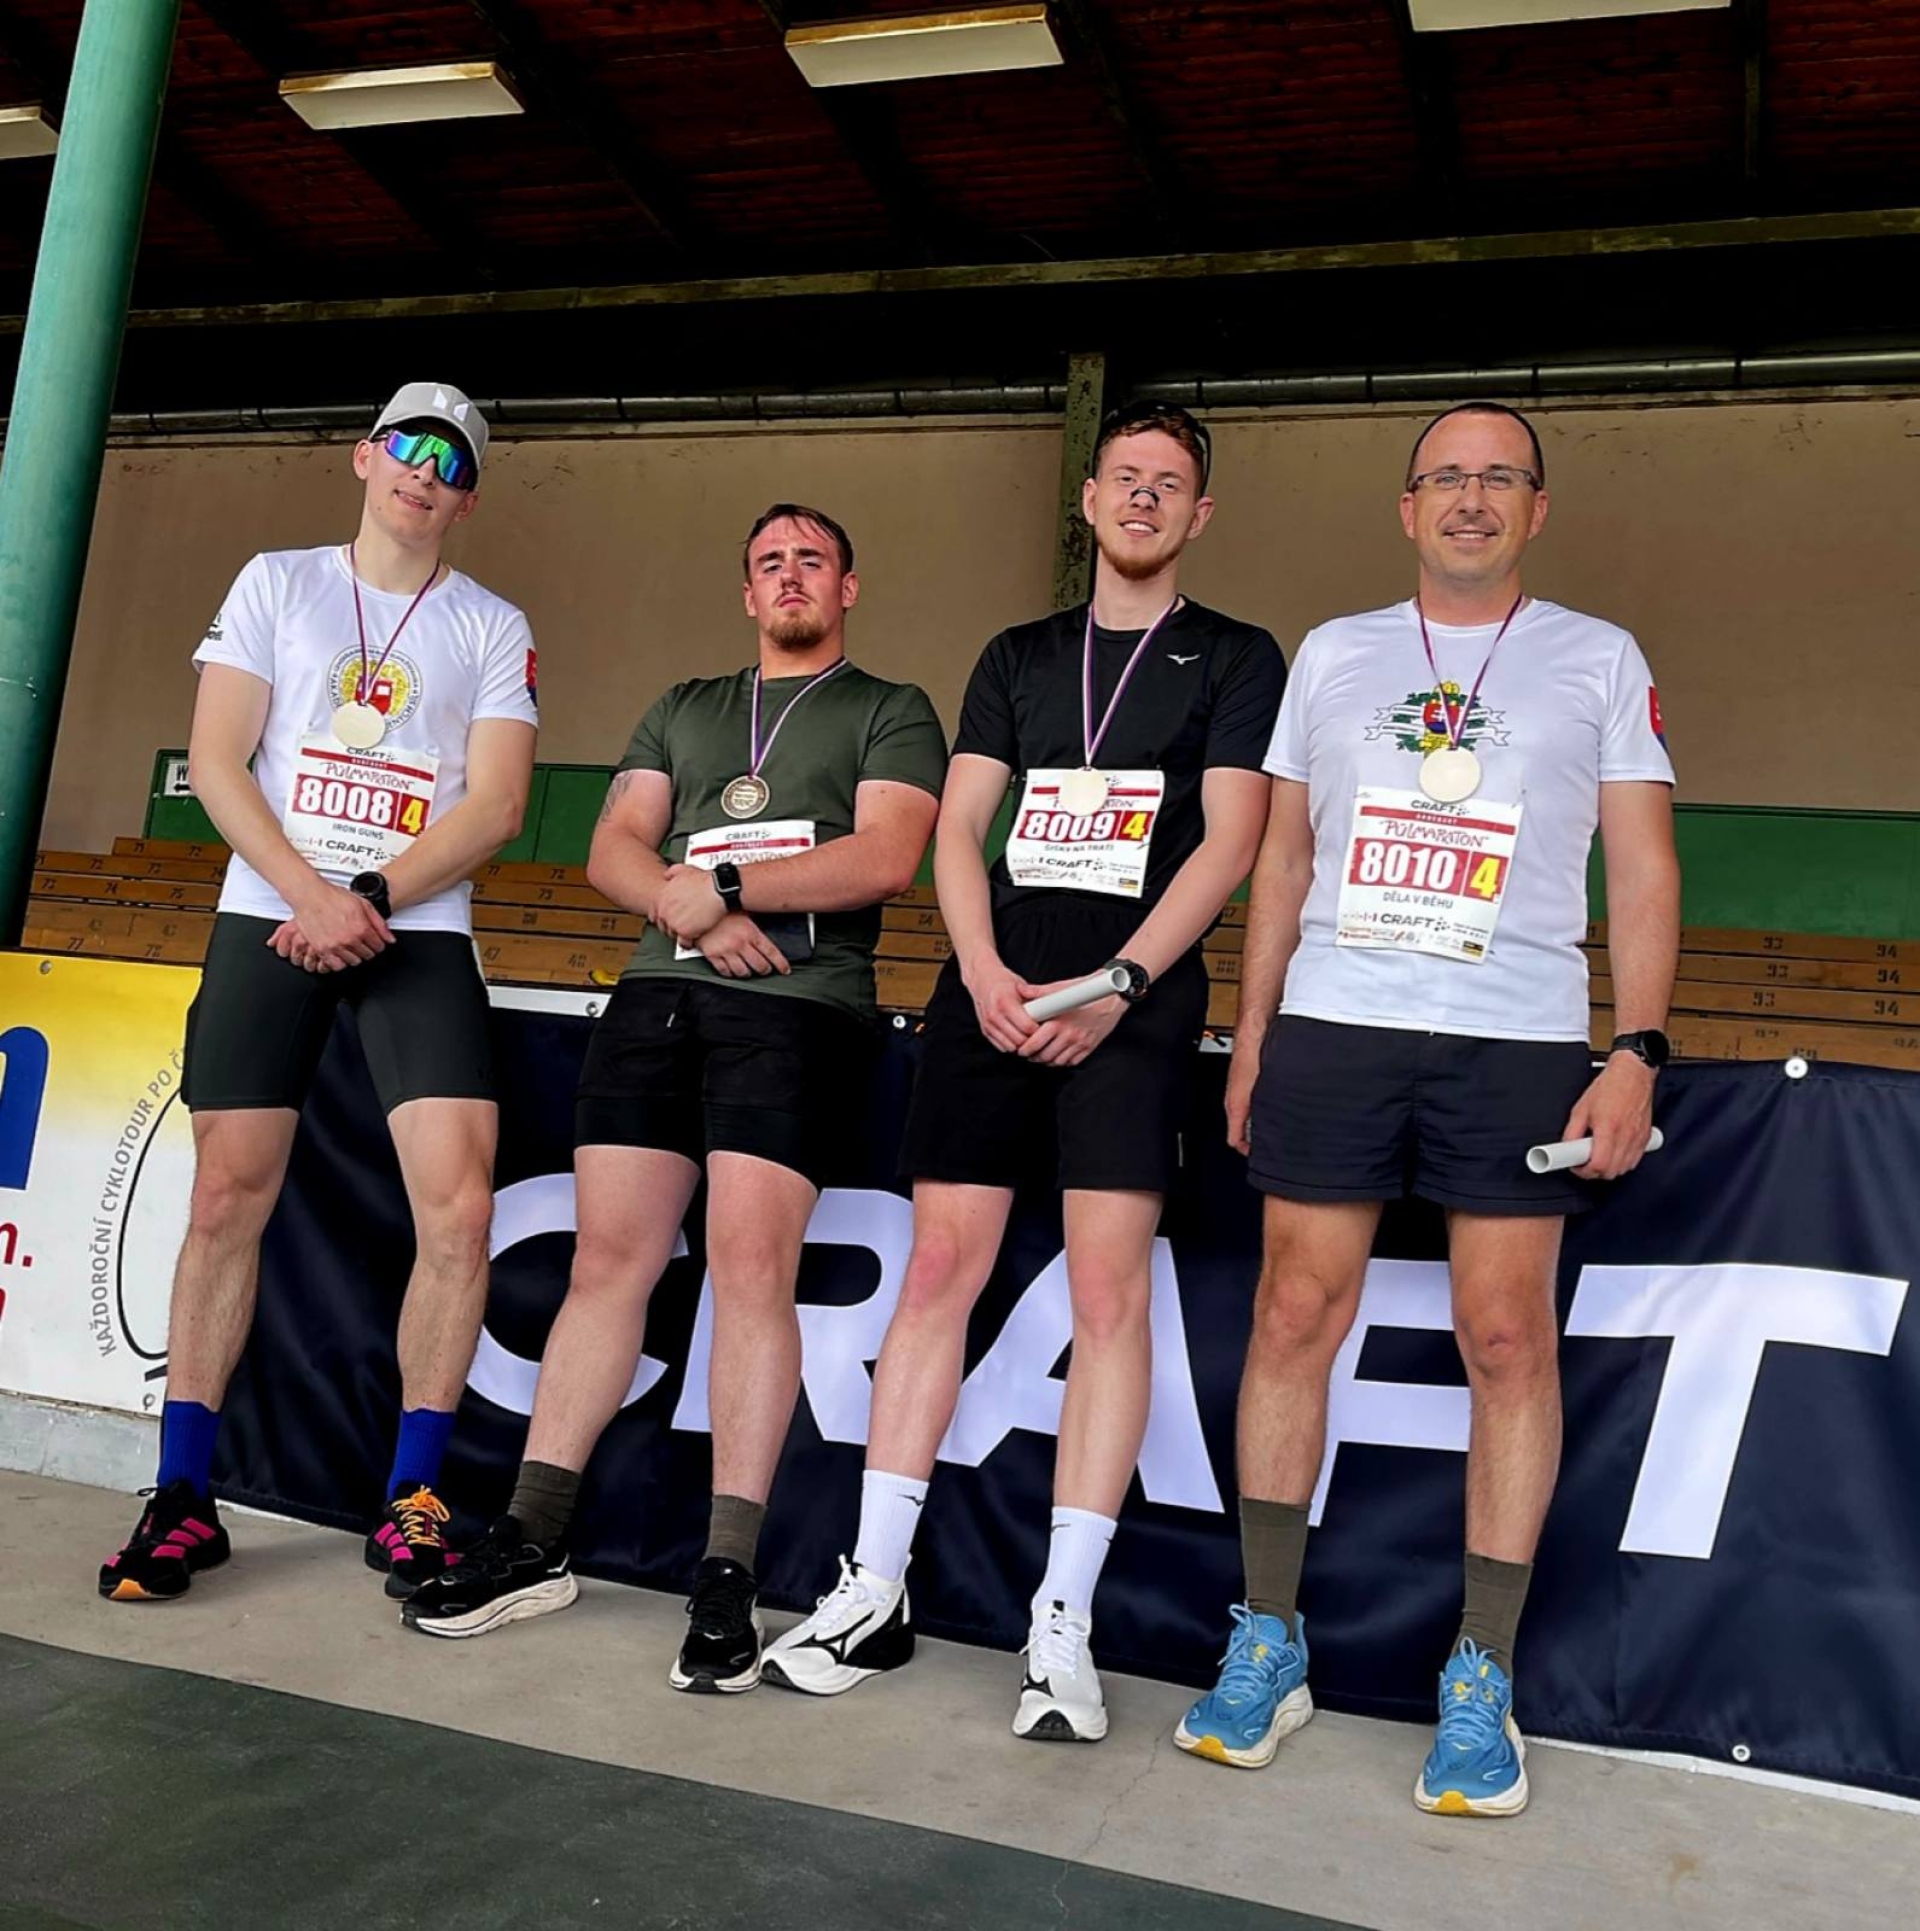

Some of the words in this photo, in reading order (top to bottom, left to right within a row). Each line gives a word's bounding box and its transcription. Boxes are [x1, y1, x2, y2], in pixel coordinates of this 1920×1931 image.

[298, 777, 394, 826] 8008
[401, 798, 424, 834] 4
[1410, 799, 1455, 813] CRAFT
[332, 822, 356, 834] IRON
[358, 827, 385, 840] GUNS
[1024, 811, 1116, 841] 8009
[1122, 811, 1147, 840] 4
[725, 831, 760, 841] CRAFT
[325, 839, 376, 856] CRAFT
[1045, 857, 1093, 868] CRAFT
[1358, 841, 1458, 891] 8010
[1469, 857, 1500, 899] 4
[1380, 913, 1435, 928] CRAFT
[1876, 943, 1898, 958] 94
[1877, 969, 1900, 984] 94
[1874, 1000, 1899, 1016] 94
[147, 1069, 173, 1098] PO
[100, 1098, 155, 1213] CYKLOTOUR
[88, 1216, 117, 1358] KAŽDOROČNÍ
[464, 1172, 1910, 1560] CRAFT
